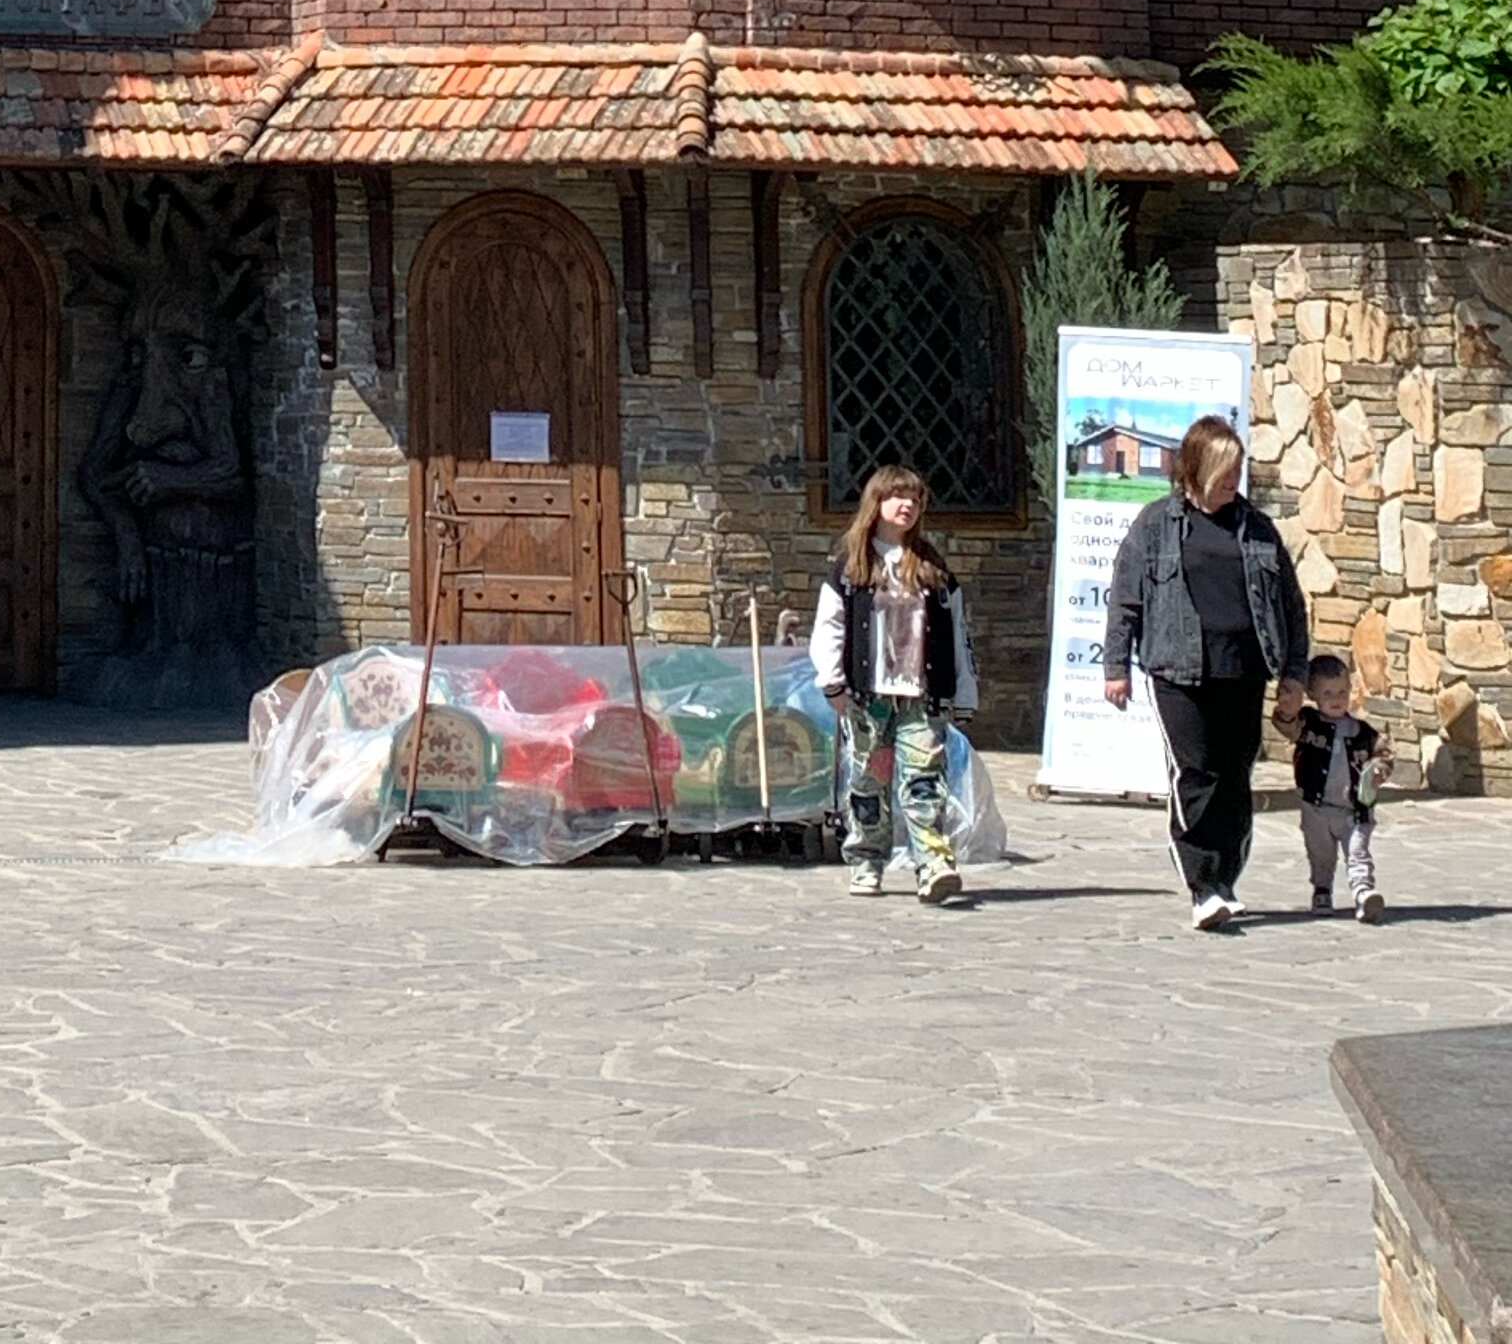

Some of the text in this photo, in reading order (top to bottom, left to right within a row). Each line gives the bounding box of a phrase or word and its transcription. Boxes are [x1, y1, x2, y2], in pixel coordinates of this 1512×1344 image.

[1086, 357, 1142, 374] ДОМ
[1071, 511, 1113, 526] Свой
[1070, 535, 1122, 548] однок
[1069, 595, 1086, 606] от
[1067, 651, 1084, 662] от
